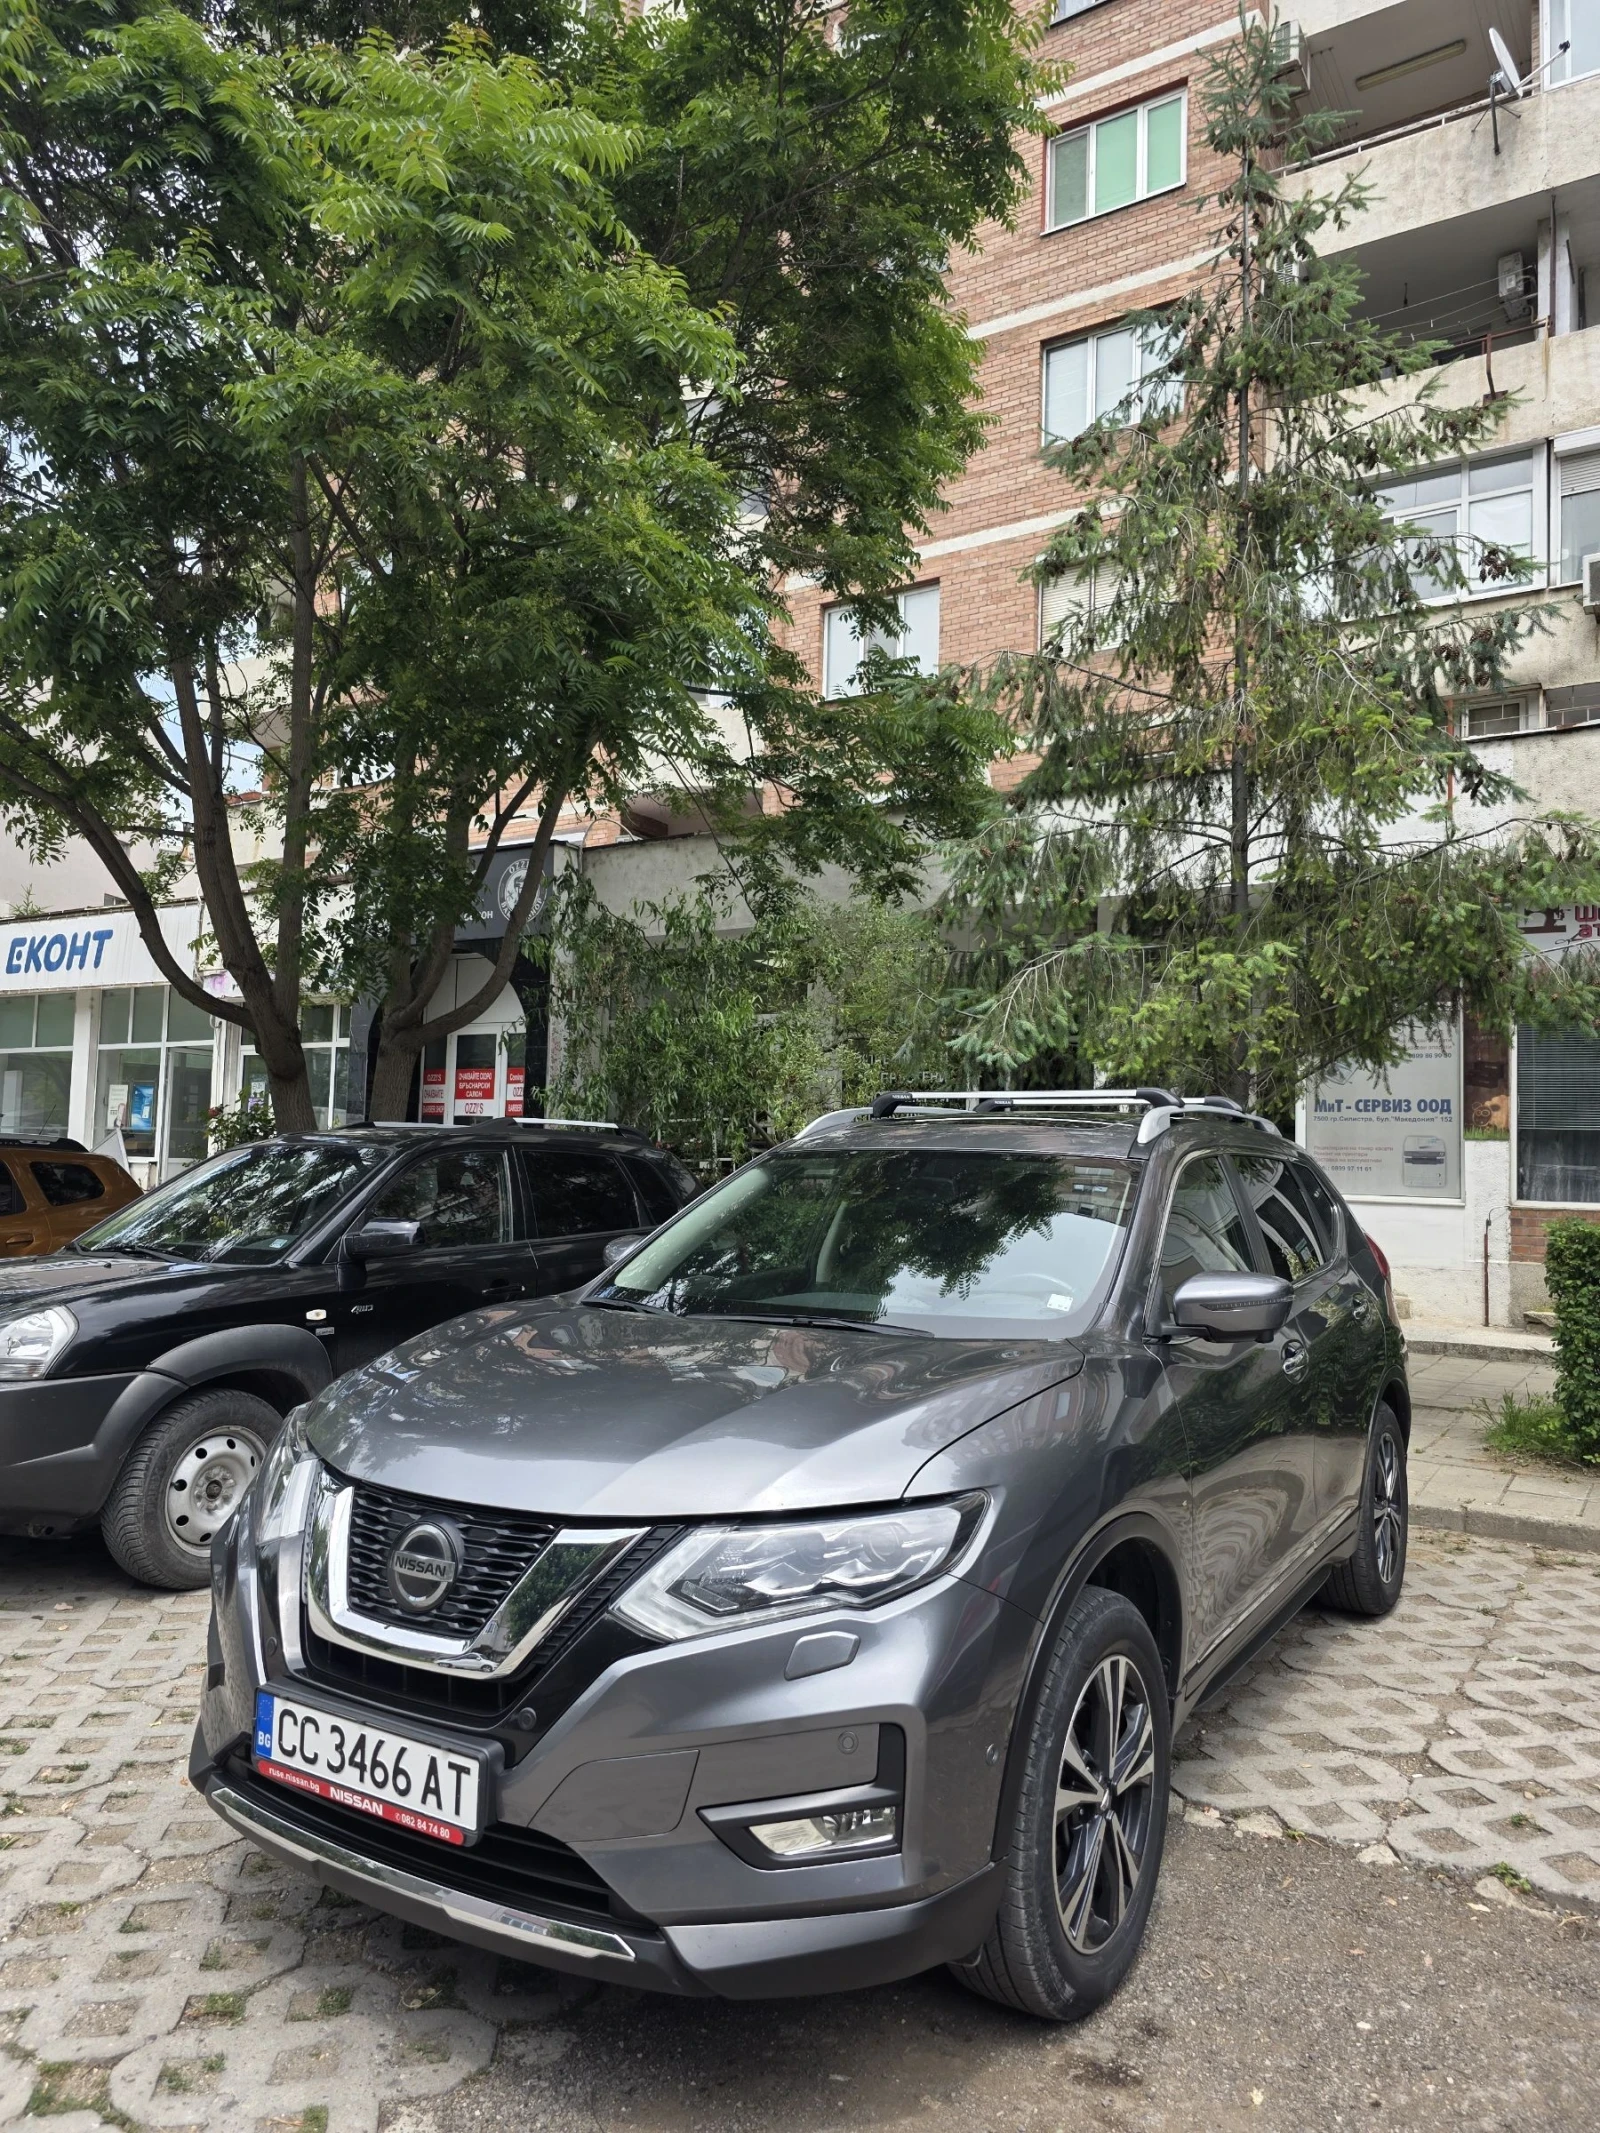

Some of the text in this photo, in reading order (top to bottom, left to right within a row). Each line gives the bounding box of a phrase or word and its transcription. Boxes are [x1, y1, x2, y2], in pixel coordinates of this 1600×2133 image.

[5, 929, 114, 974] ЕКОНТ
[1314, 1099, 1344, 1113] МиТ
[1354, 1099, 1412, 1113] СЕРВИЗ
[1417, 1099, 1452, 1115] ООД
[395, 1556, 447, 1577] NISSAN
[258, 1730, 271, 1748] BG
[278, 1708, 471, 1816] CC 3466 AT
[268, 1767, 450, 1839] ruse.nissan.bg NISSAN 082 84 74 80
